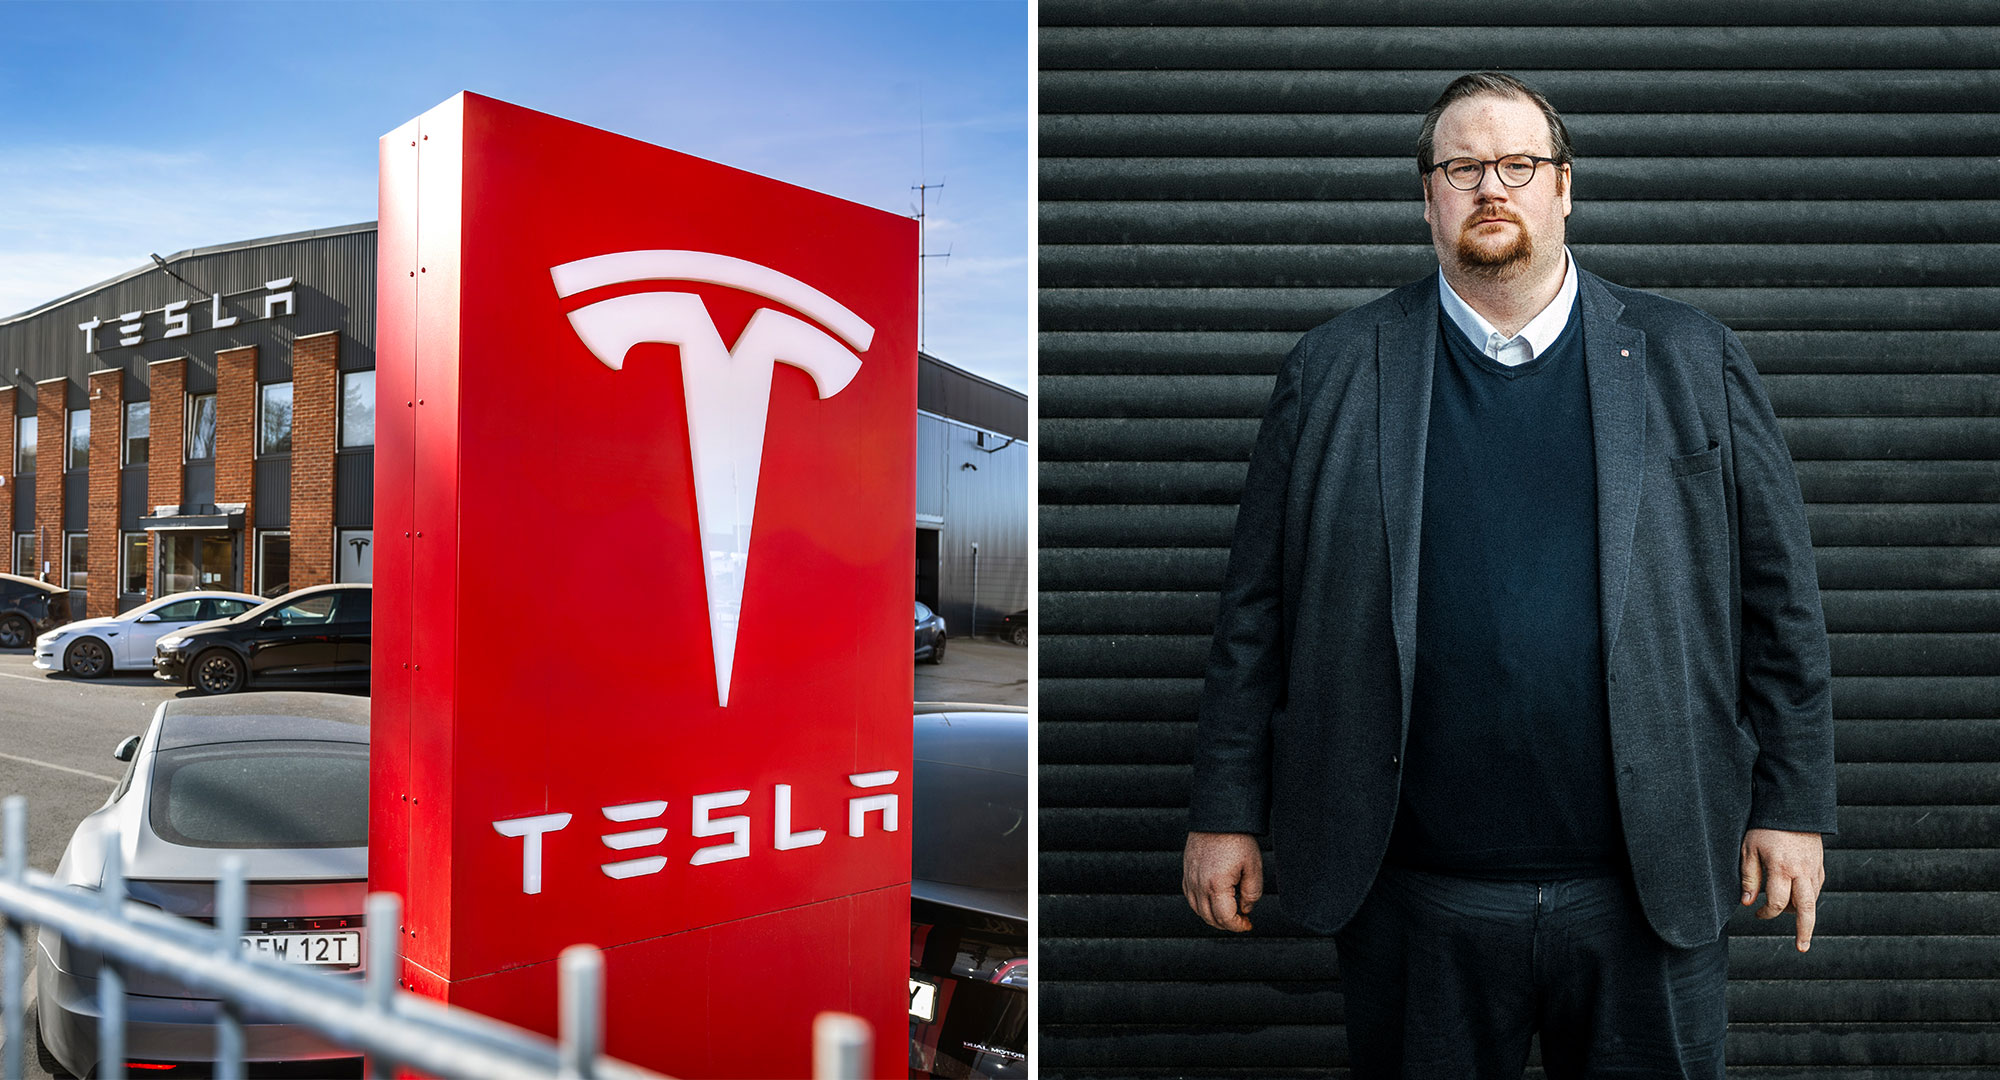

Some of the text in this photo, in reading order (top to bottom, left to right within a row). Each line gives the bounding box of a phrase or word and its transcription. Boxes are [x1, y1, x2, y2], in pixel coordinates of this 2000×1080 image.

[78, 276, 296, 353] TESLA
[492, 770, 899, 895] TESLA
[300, 938, 348, 961] 12T
[963, 1041, 1025, 1059] DUAL MOTOR
